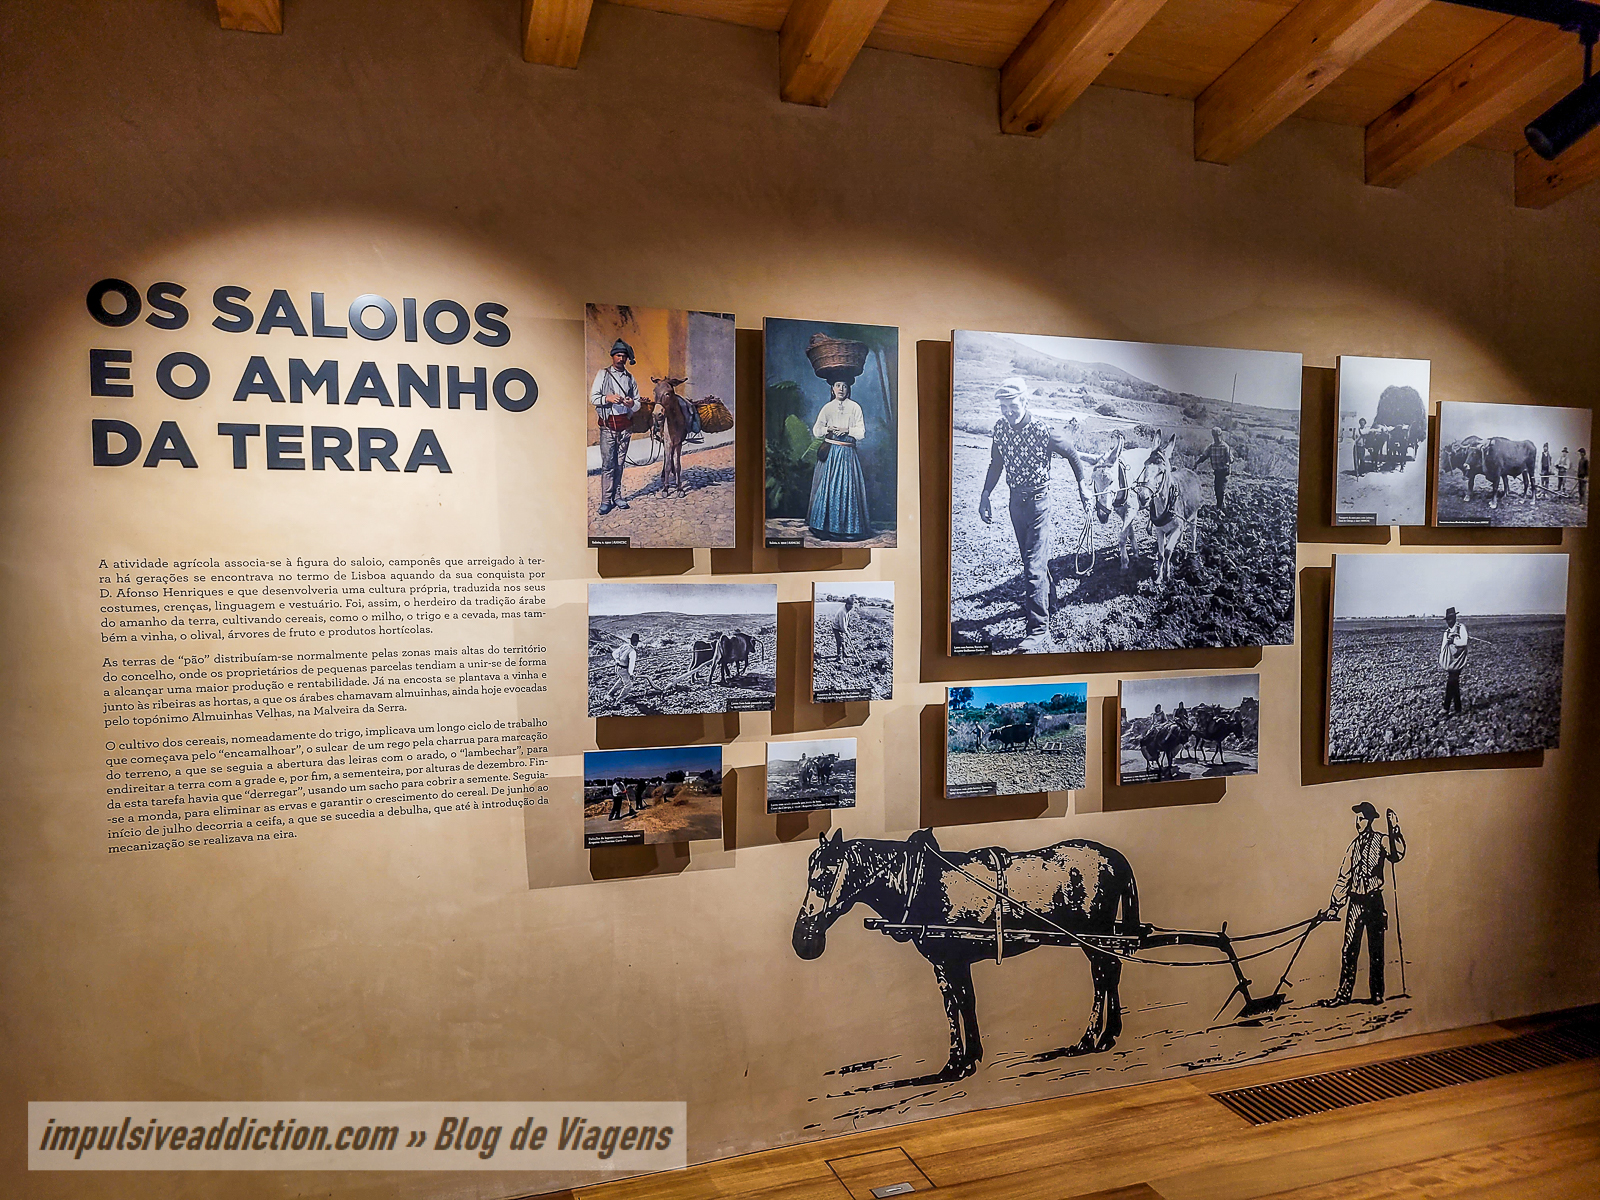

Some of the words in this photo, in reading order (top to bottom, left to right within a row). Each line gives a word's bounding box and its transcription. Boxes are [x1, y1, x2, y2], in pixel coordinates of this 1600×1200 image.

[86, 278, 189, 330] OS
[212, 286, 511, 347] SALOIOS
[90, 349, 134, 397] E
[156, 352, 210, 400] O
[233, 356, 538, 412] AMANHO
[92, 419, 198, 468] DA
[218, 423, 452, 473] TERRA
[113, 557, 169, 569] atividade
[173, 557, 221, 571] agrícola
[224, 558, 282, 568] associa-se
[296, 556, 330, 569] figura
[350, 556, 385, 568] saloio,
[388, 556, 441, 568] camponês
[467, 555, 515, 568] arreigado
[135, 573, 189, 586] gerações
[210, 573, 274, 582] encontrava
[296, 573, 330, 581] termo
[351, 570, 387, 581] Lisboa
[390, 569, 435, 582] aquando
[476, 569, 525, 581] conquista
[99, 604, 160, 614] costumes,
[163, 603, 212, 614] crenças,
[214, 600, 276, 613] linguagem
[288, 599, 343, 609] vestuário.
[367, 598, 401, 609] assim,
[413, 596, 457, 607] herdeiro
[474, 595, 516, 607] tradição
[518, 595, 546, 605] árabe
[115, 587, 159, 598] Afonso
[162, 587, 224, 599] Henriques
[261, 584, 339, 596] desenvolveria
[368, 583, 407, 594] cultura
[409, 584, 450, 596] própria,
[452, 582, 501, 593] traduzida
[119, 616, 168, 628] amanho
[188, 617, 219, 627] terra,
[222, 613, 282, 625] cultivando
[284, 613, 327, 624] cereais,
[329, 615, 359, 623] como
[371, 610, 404, 622] milho,
[416, 611, 442, 623] trigo
[461, 609, 499, 620] cevada,
[140, 630, 177, 643] vinha,
[190, 629, 225, 641] olival,
[227, 629, 270, 639] árvores
[289, 627, 317, 638] fruto
[327, 625, 377, 639] produtos
[378, 624, 433, 635] hortícolas.
[120, 669, 176, 682] concelho,
[178, 668, 208, 680] onde
[225, 666, 299, 680] proprietários
[316, 665, 368, 676] pequenas
[369, 660, 413, 674] parcelas
[415, 659, 457, 671] tendiam
[467, 659, 502, 669] unir-se
[518, 656, 547, 667] forma
[122, 658, 157, 667] terras
[213, 652, 294, 664] distribuíam-se
[296, 649, 368, 661] normalmente
[371, 647, 399, 661] pelas
[401, 649, 431, 657] zonas
[434, 646, 458, 656] mais
[461, 645, 485, 656] altas
[502, 644, 547, 654] território
[102, 702, 135, 715] junto
[152, 698, 197, 710] ribeiras
[212, 696, 252, 707] hortas,
[299, 691, 335, 703] árabes
[336, 690, 393, 701] chamavam
[395, 686, 450, 699] almuinhas,
[451, 685, 480, 696] ainda
[480, 684, 502, 696] hoje
[503, 682, 548, 694] evocadas
[113, 685, 164, 698] alcançar
[195, 683, 230, 693] maior
[232, 680, 285, 694] produção
[297, 676, 370, 689] rentabilidade.
[403, 675, 443, 685] encosta
[458, 672, 501, 685] plantava
[511, 669, 539, 680] vinha
[104, 715, 130, 729] pelo
[132, 713, 189, 727] topónimo
[191, 709, 254, 722] Almuinhas
[255, 707, 295, 721] Velhas,
[313, 704, 360, 716] Malveira
[377, 703, 407, 713] Serra.
[118, 738, 160, 750] cultivo
[185, 735, 229, 747] cereais,
[231, 731, 317, 744] nomeadamente
[334, 728, 364, 740] trigo,
[365, 725, 417, 738] implicava
[436, 722, 466, 734] longo
[467, 720, 492, 731] ciclo
[507, 717, 548, 729] trabalho
[130, 754, 190, 765] começava
[191, 749, 217, 763] pelo
[315, 742, 349, 753] sulcar
[386, 741, 411, 751] rego
[412, 736, 435, 750] pela
[436, 735, 476, 746] charrua
[477, 736, 500, 746] para
[501, 731, 548, 743] marcação
[106, 782, 166, 795] endireitar
[177, 781, 206, 790] terra
[243, 773, 277, 788] grade
[342, 767, 404, 779] sementeira,
[425, 763, 461, 774] alturas
[476, 758, 528, 770] dezembro.
[124, 769, 172, 779] terreno,
[226, 761, 264, 774] seguia
[276, 758, 324, 770] abertura
[348, 754, 378, 765] leiras
[416, 749, 448, 761] arado,
[526, 746, 549, 756] para
[123, 799, 149, 809] esta
[150, 794, 186, 807] tarefa
[187, 793, 220, 804] havia
[307, 783, 348, 795] usando
[368, 779, 399, 791] sacho
[401, 780, 425, 791] para
[426, 776, 458, 787] cobrir
[466, 774, 511, 784] semente.
[512, 770, 549, 782] Seguia-
[137, 809, 182, 822] monda,
[184, 810, 211, 821] para
[212, 805, 261, 816] eliminar
[278, 802, 308, 811] ervas
[319, 796, 364, 810] garantir
[374, 792, 439, 804] crescimento
[456, 786, 489, 798] cereal.
[506, 783, 535, 797] junho
[107, 827, 142, 839] início
[161, 822, 193, 837] julho
[195, 819, 244, 832] decorria
[255, 815, 286, 827] ceifa,
[334, 808, 376, 821] sucedia
[387, 804, 432, 817] debulha,
[481, 797, 535, 809] introdução
[108, 838, 185, 854] mecanização
[203, 833, 254, 846] realizava
[273, 830, 298, 840] eira.
